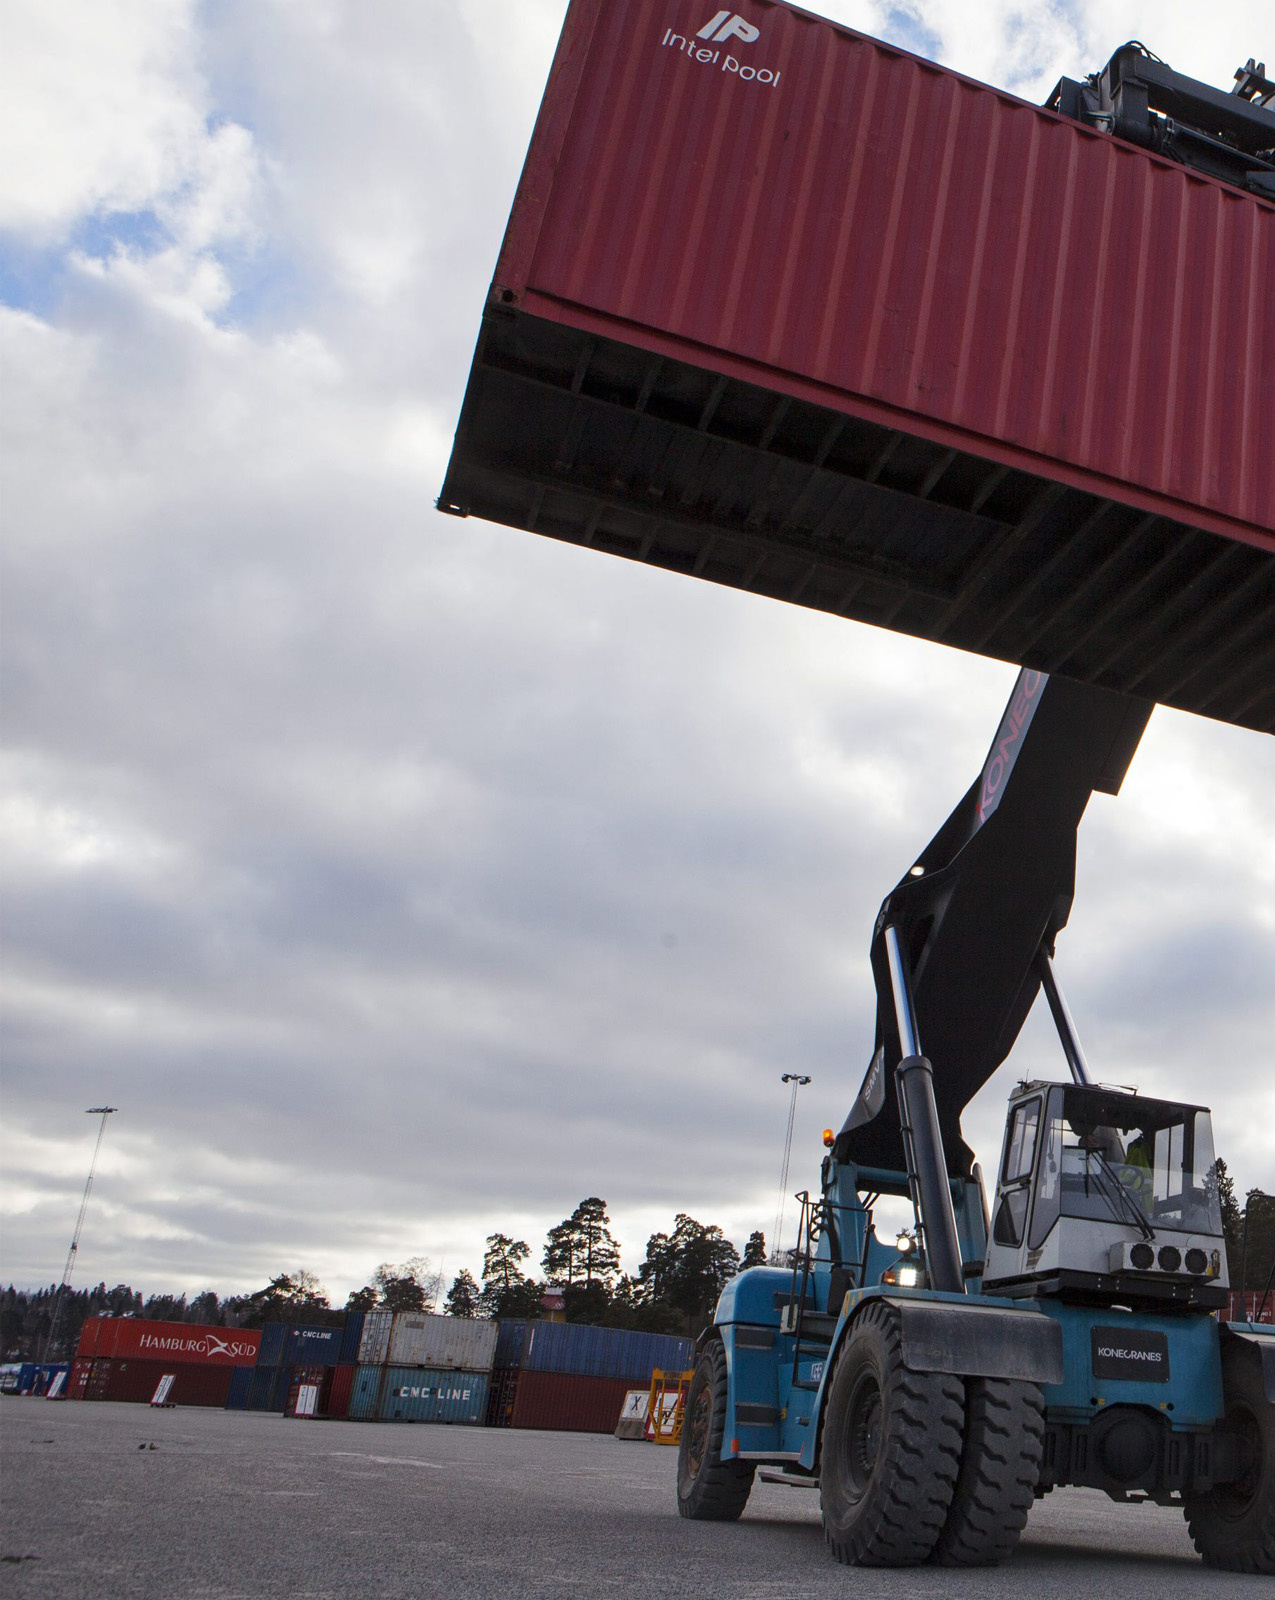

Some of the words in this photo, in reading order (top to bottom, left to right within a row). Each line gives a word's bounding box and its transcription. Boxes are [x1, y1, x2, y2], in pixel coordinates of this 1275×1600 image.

[696, 10, 760, 43] IP
[661, 28, 720, 64] Intel
[721, 55, 781, 88] pool
[139, 1334, 206, 1352] HAMBURG
[231, 1341, 256, 1356] SÜD
[1098, 1347, 1163, 1362] KONECRANES
[400, 1386, 431, 1399] CNC
[437, 1388, 471, 1401] LINE
[631, 1395, 642, 1411] X
